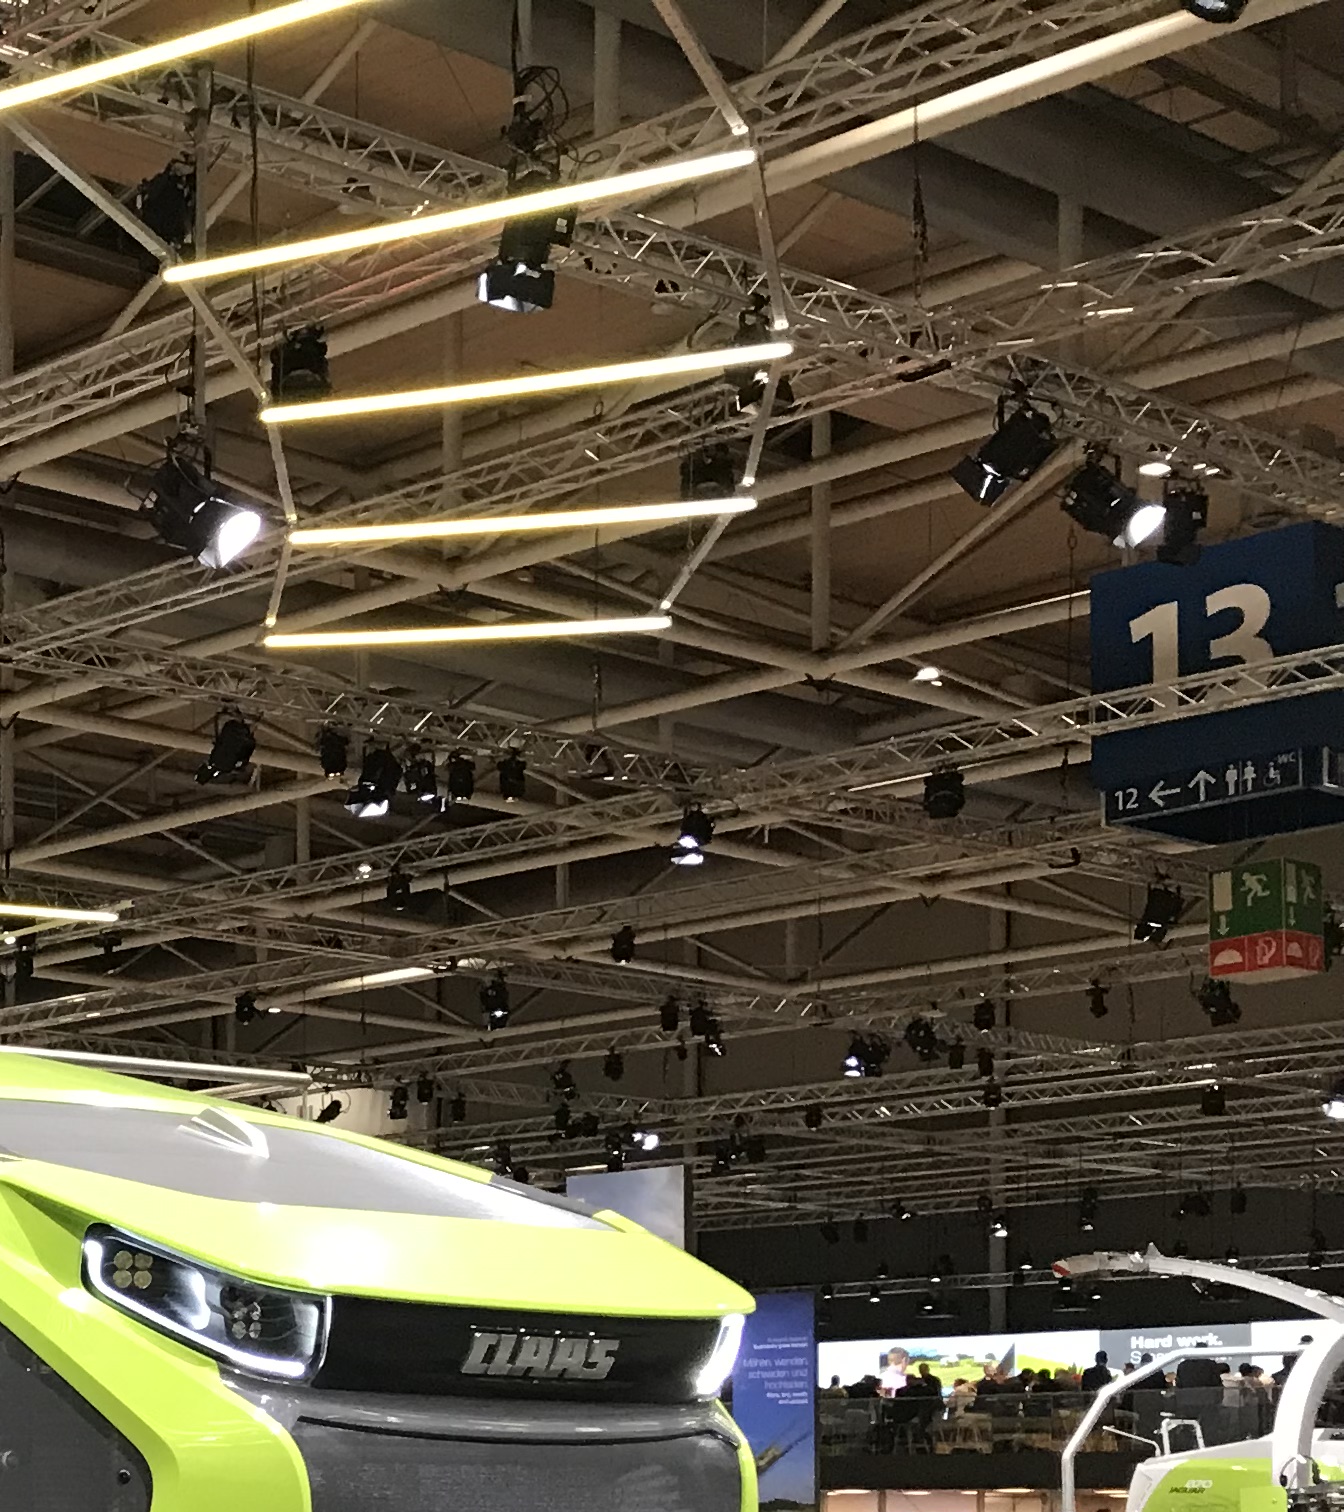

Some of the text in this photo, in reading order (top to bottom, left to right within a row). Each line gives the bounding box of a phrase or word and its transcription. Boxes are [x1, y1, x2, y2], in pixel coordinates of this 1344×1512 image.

[1129, 583, 1274, 713] 13
[1277, 752, 1295, 764] WC
[1115, 788, 1140, 811] 12
[1130, 1332, 1223, 1349] Hard work.
[461, 1328, 621, 1380] CLAAS
[1168, 1486, 1206, 1494] JAGUAR
